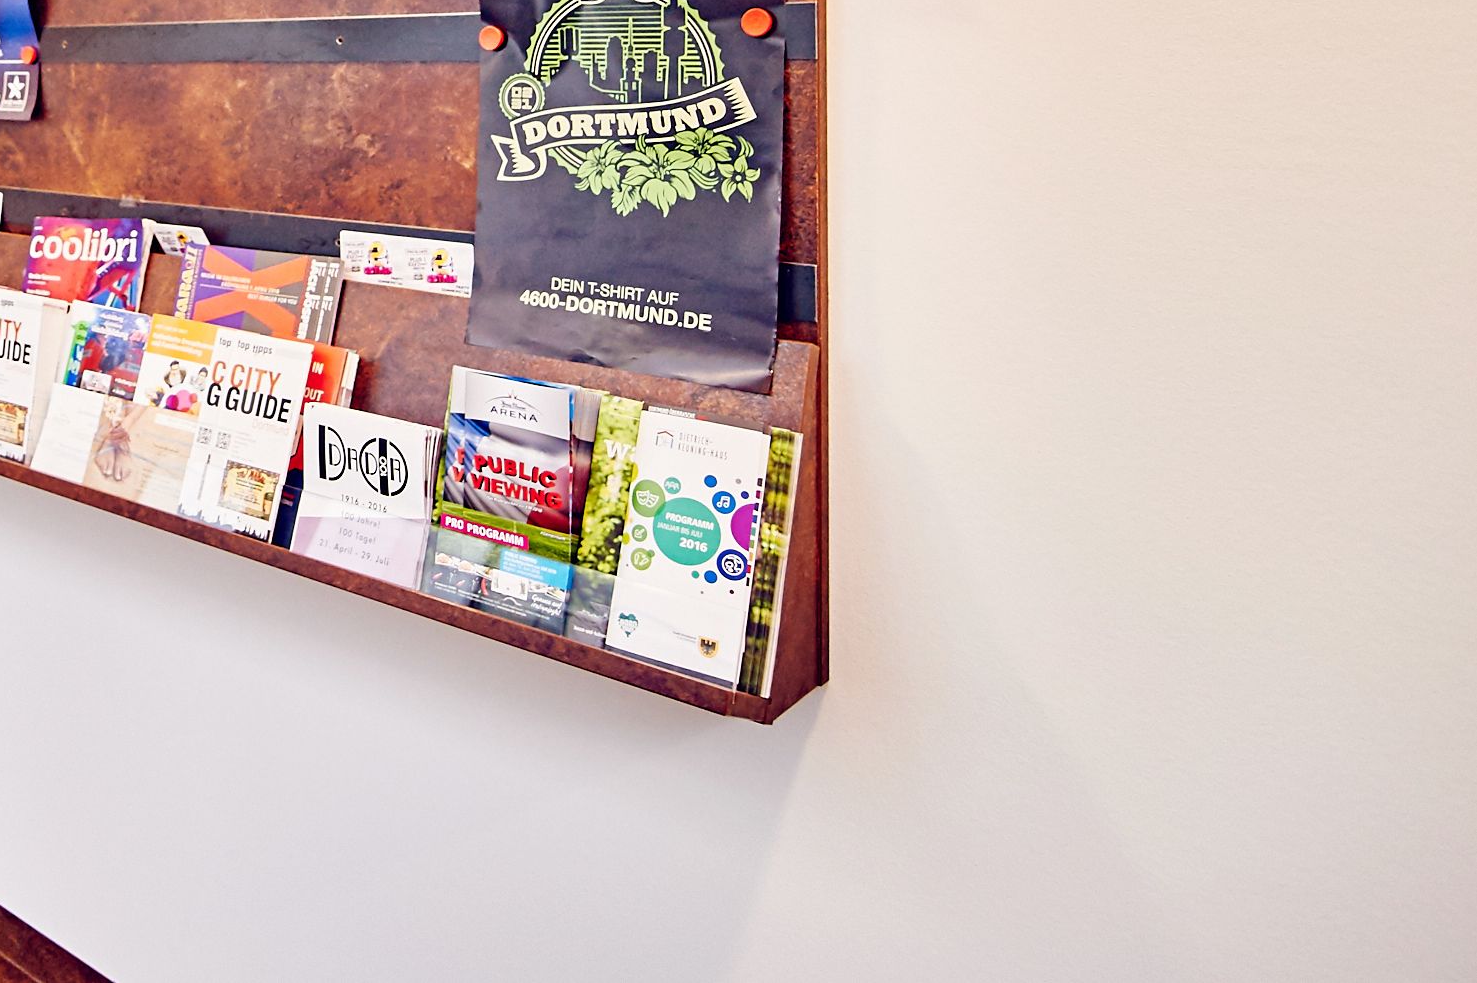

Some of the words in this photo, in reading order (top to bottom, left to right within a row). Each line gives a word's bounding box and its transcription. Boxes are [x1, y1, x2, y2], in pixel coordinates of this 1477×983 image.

[522, 97, 727, 145] DORTMUND
[29, 227, 138, 262] coolibri
[550, 276, 585, 294] DEIN
[587, 281, 645, 302] T-SHIRT
[647, 289, 680, 306] AUF
[519, 288, 713, 332] 4600-DORTMUND.DE
[238, 339, 250, 350] top
[230, 363, 282, 395] CITY
[312, 361, 325, 375] IN
[225, 386, 292, 424] GUIDE
[490, 405, 539, 423] ARENA
[473, 454, 558, 489] PUBLIC
[340, 493, 359, 507] 1916
[368, 500, 388, 514] 2016
[470, 472, 563, 510] VIEWING
[444, 515, 465, 531] PRO
[466, 519, 524, 548] PROGRAMM
[665, 512, 715, 531] PROGRAMM
[679, 537, 708, 553] 2016
